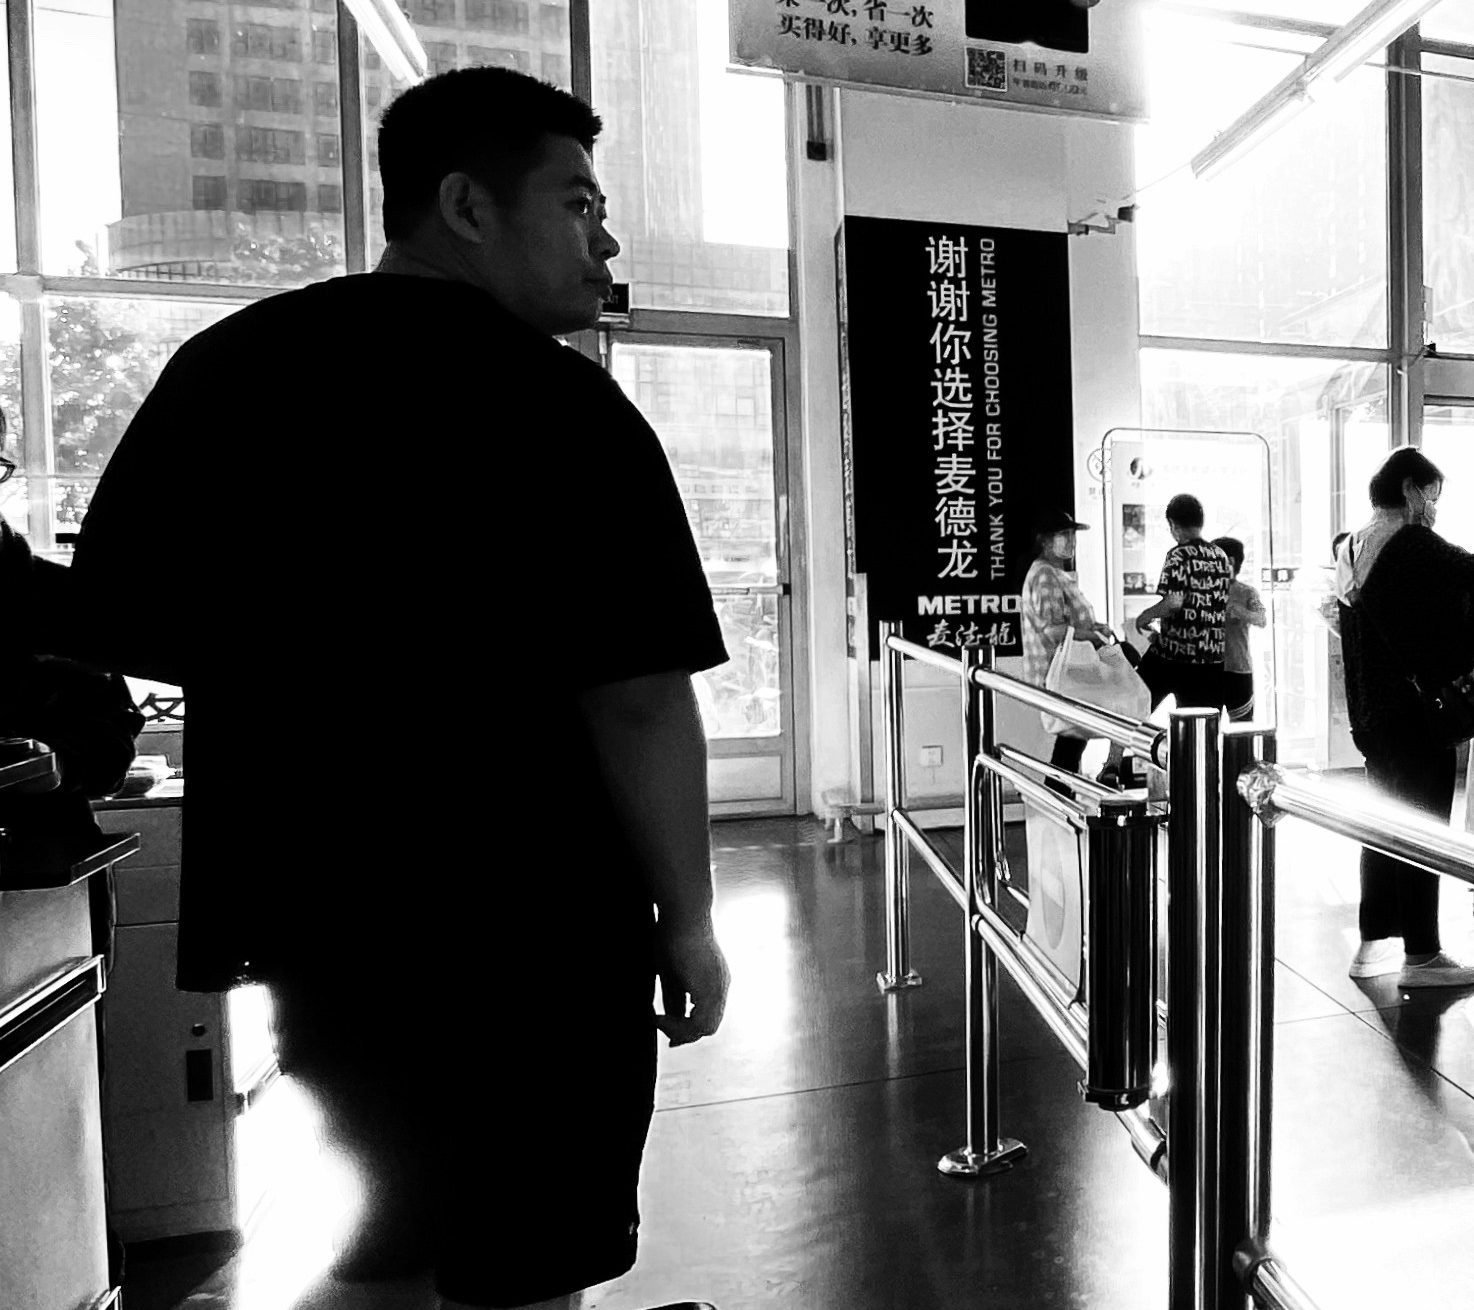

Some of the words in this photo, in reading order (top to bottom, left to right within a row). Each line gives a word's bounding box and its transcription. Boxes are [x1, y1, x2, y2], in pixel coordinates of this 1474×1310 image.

[980, 238, 997, 307] METRO
[982, 313, 1001, 417] CHOOSING
[925, 235, 978, 580] 谢谢你选择麦德龙
[986, 422, 1002, 461] FOR
[987, 467, 1004, 507] YOU
[989, 514, 1006, 581] THANK
[918, 594, 1021, 616] METRO
